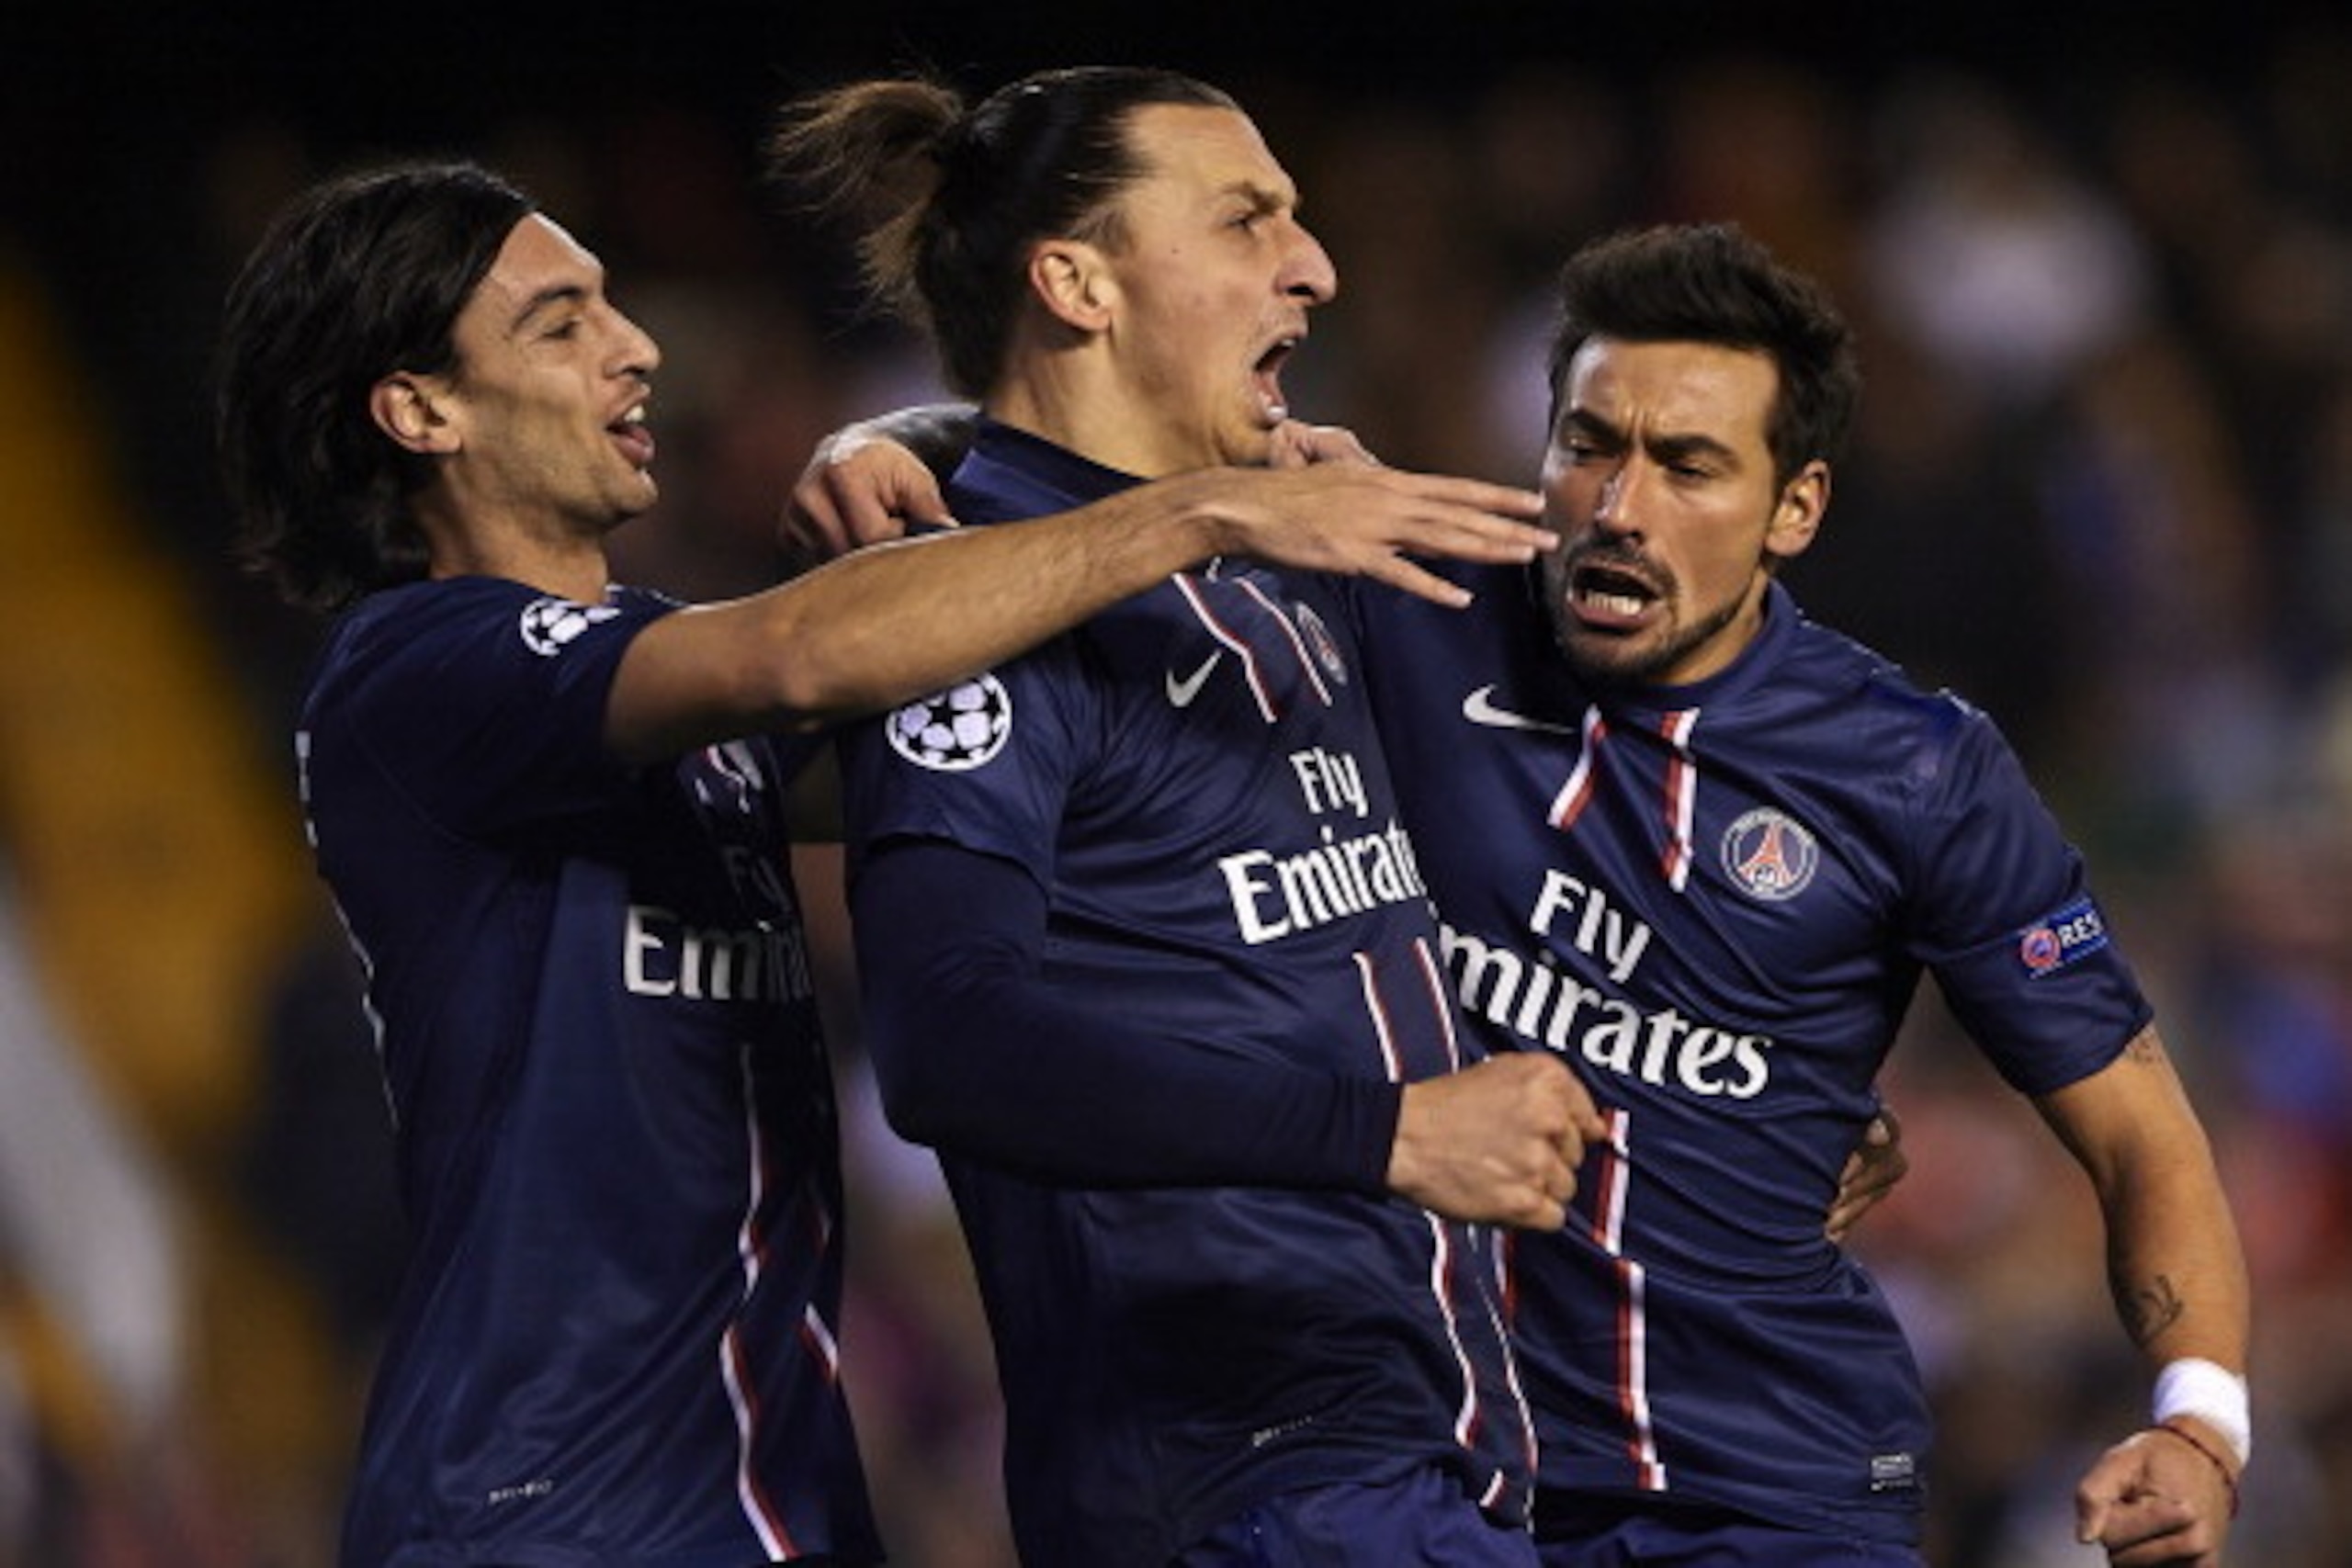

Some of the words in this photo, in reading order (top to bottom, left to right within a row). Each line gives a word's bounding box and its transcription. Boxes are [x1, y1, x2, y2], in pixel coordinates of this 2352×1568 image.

[1288, 745, 1369, 818] Fly
[1529, 869, 1652, 985] Fly
[1430, 902, 1774, 1099] mirates
